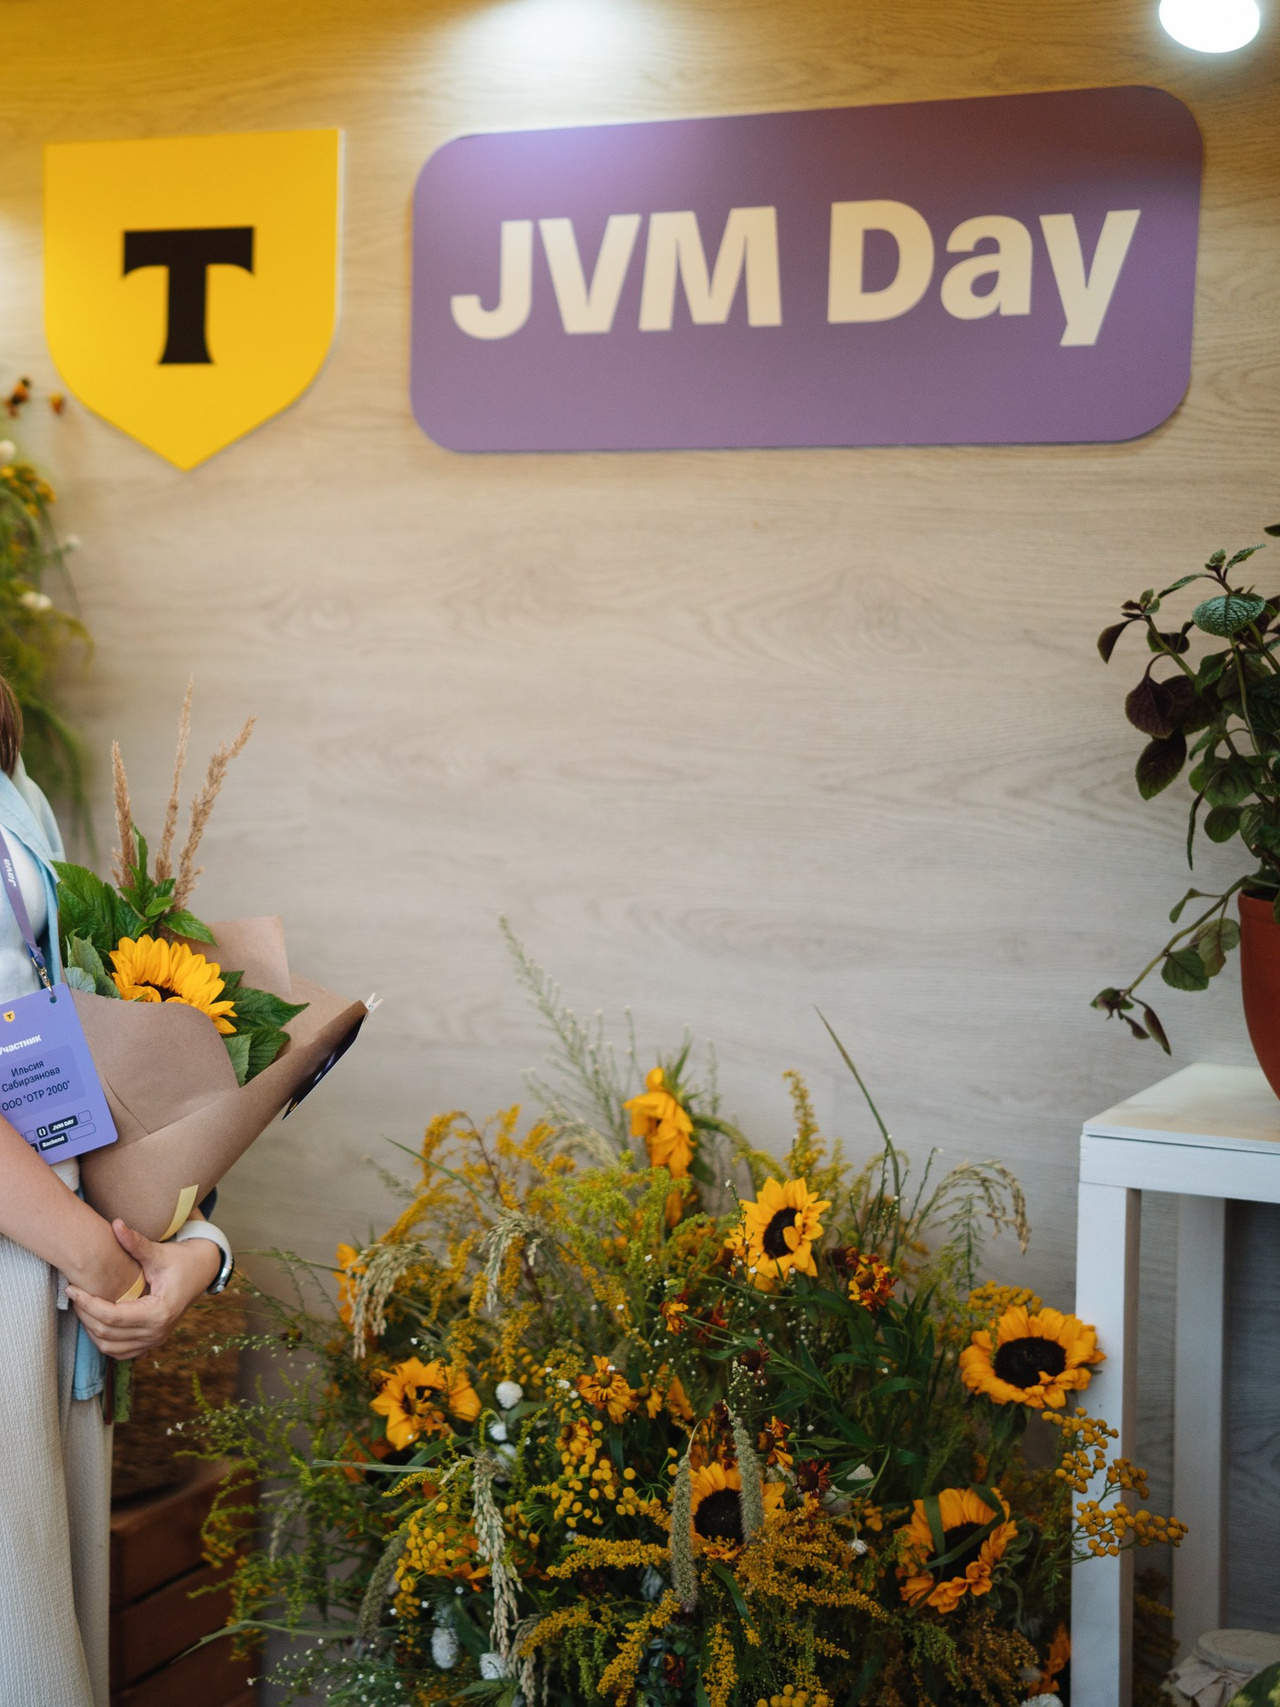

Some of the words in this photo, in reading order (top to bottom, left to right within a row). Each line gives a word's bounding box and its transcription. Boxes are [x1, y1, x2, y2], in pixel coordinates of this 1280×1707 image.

[450, 205, 783, 341] JVM
[827, 199, 1141, 347] Day
[3, 858, 17, 888] Java
[1, 1066, 61, 1093] Сабирзянова
[11, 1060, 45, 1077] Ильсия
[42, 1135, 65, 1148] Backend
